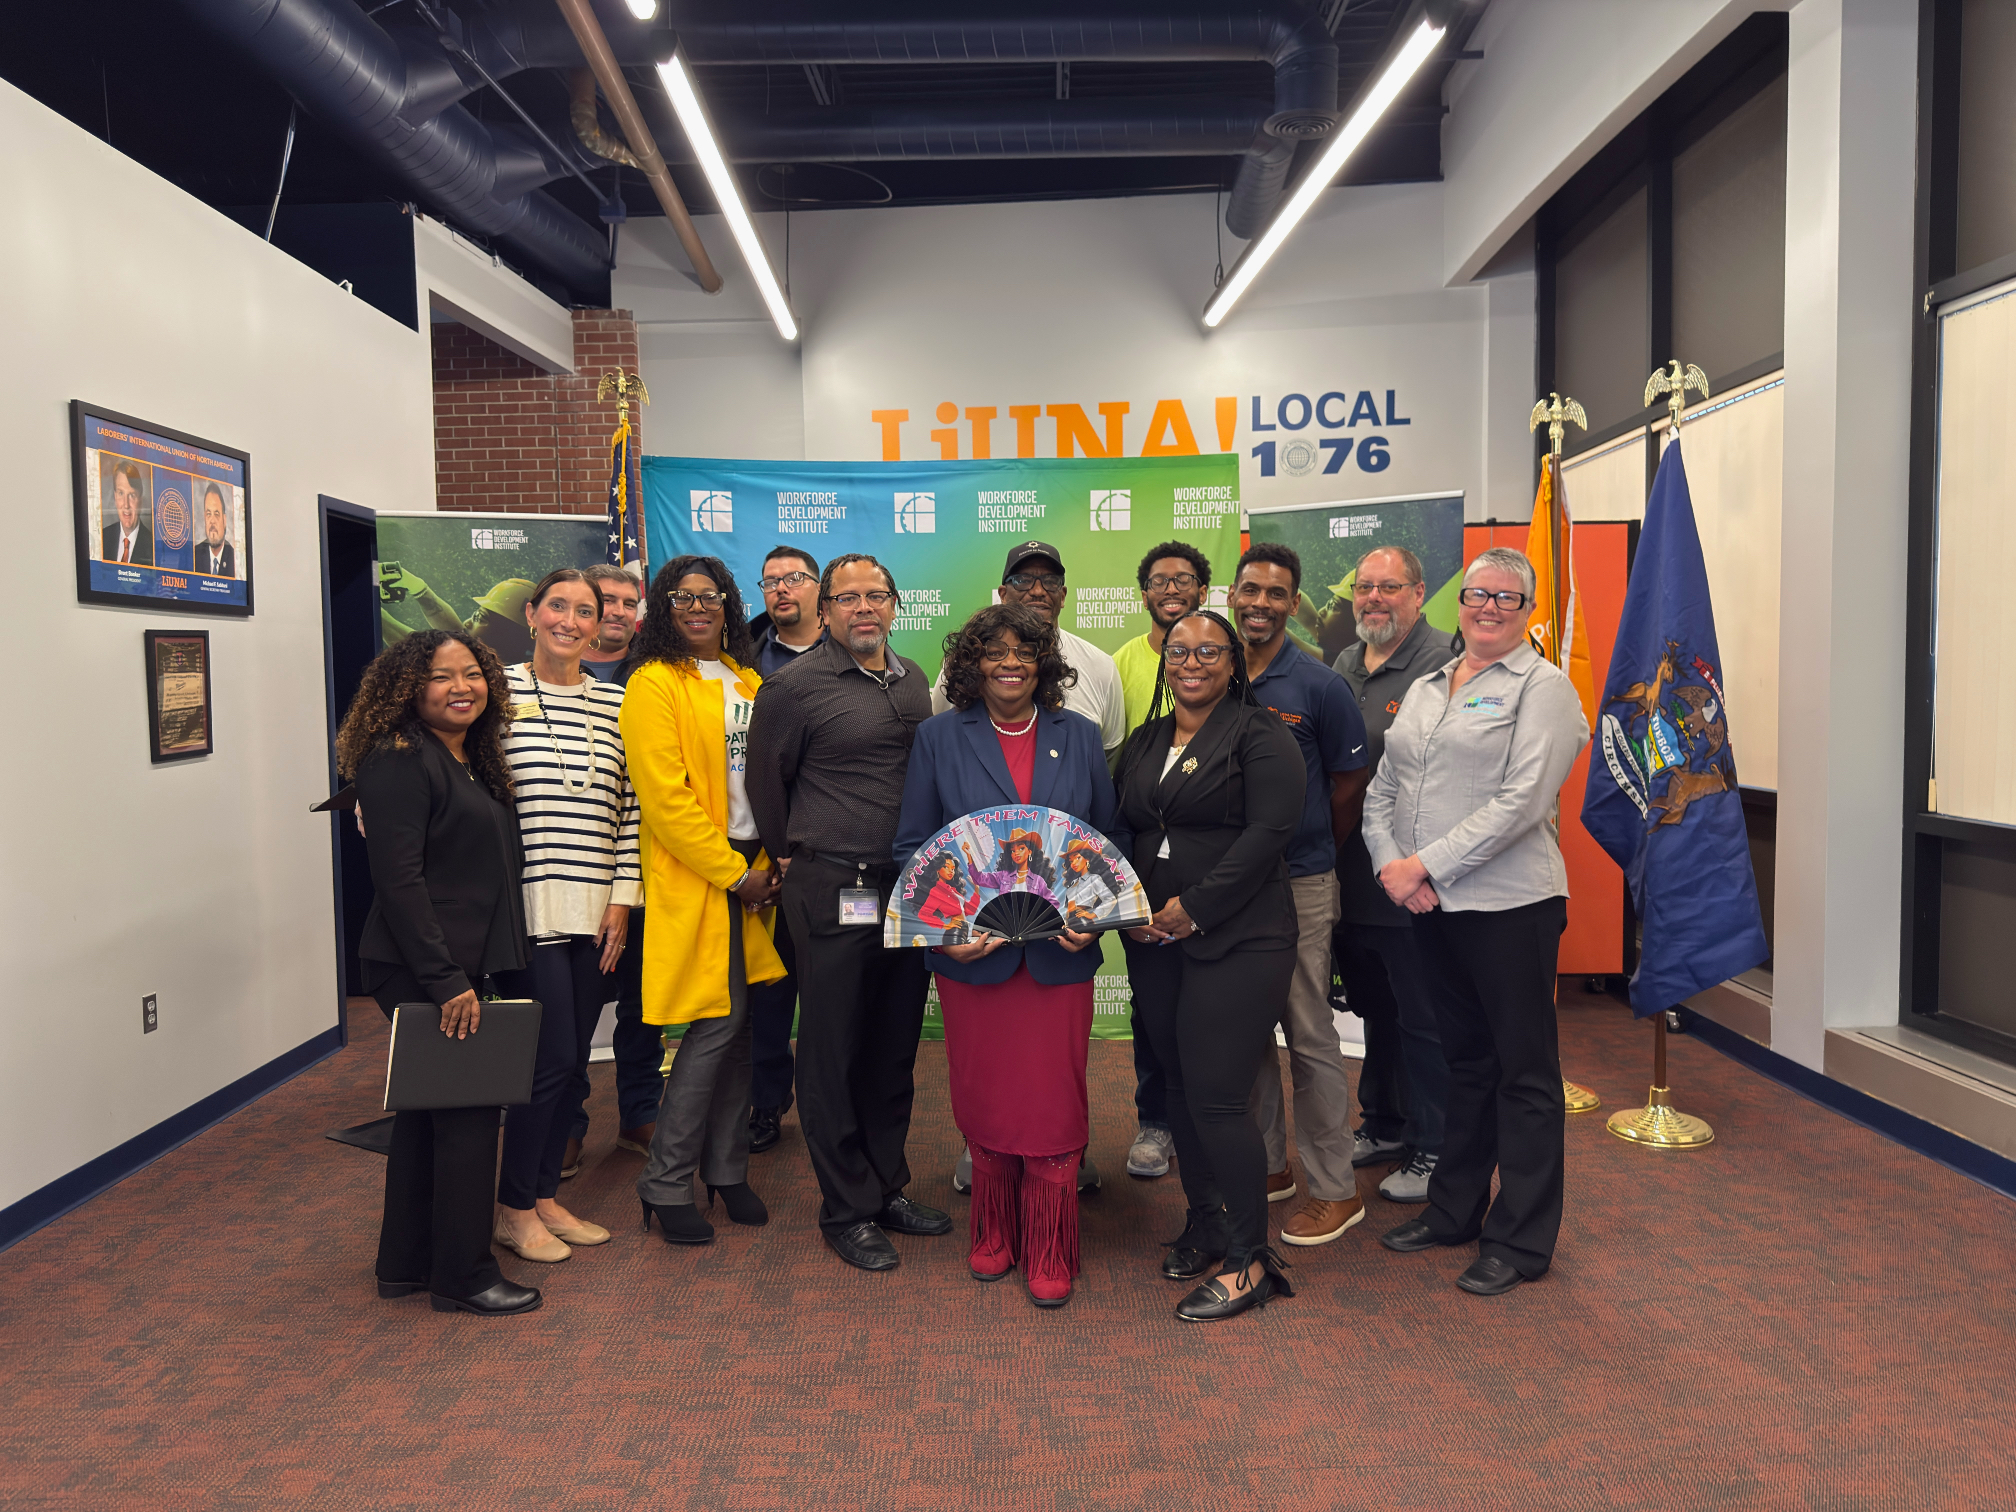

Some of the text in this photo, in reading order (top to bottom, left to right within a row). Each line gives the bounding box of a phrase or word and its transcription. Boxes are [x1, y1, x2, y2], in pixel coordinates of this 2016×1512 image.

[1251, 390, 1411, 431] LOCAL
[129, 435, 172, 455] INTERNATIONAL
[171, 447, 189, 459] UNION
[189, 453, 197, 461] OF
[196, 455, 214, 467] NORTH
[213, 460, 234, 472] AMERICA
[777, 492, 838, 505] WORKFORCE
[978, 490, 1037, 504] WORKFORCE
[1173, 486, 1232, 500] WORKFORCE
[778, 506, 847, 519] DEVELOPMENT
[978, 504, 1046, 518] DEVELOPMENT
[1173, 500, 1240, 515] DEVELOPMENT
[978, 519, 1028, 532] INSTITUTE
[1173, 515, 1222, 529] INSTITUTE
[1350, 514, 1378, 523] WORKFORCE
[1350, 521, 1382, 530] DEVELOPMENT
[778, 520, 829, 533] INSTITUTE
[1350, 528, 1373, 537] INSTITUTE
[494, 536, 528, 544] DEVELOPMENT
[161, 575, 188, 589] LiUNA!
[897, 589, 942, 603] RKFORCE
[1076, 587, 1135, 601] WORKFORCE
[894, 603, 951, 617] VELOPMENT
[1076, 601, 1144, 615] DEVELOPMENT
[1076, 615, 1125, 629] INSTITUTE
[1652, 713, 1676, 766] TUEBOR
[903, 809, 1128, 900] WHERE THEM FANS AT
[1093, 1002, 1126, 1015] TITUTE
